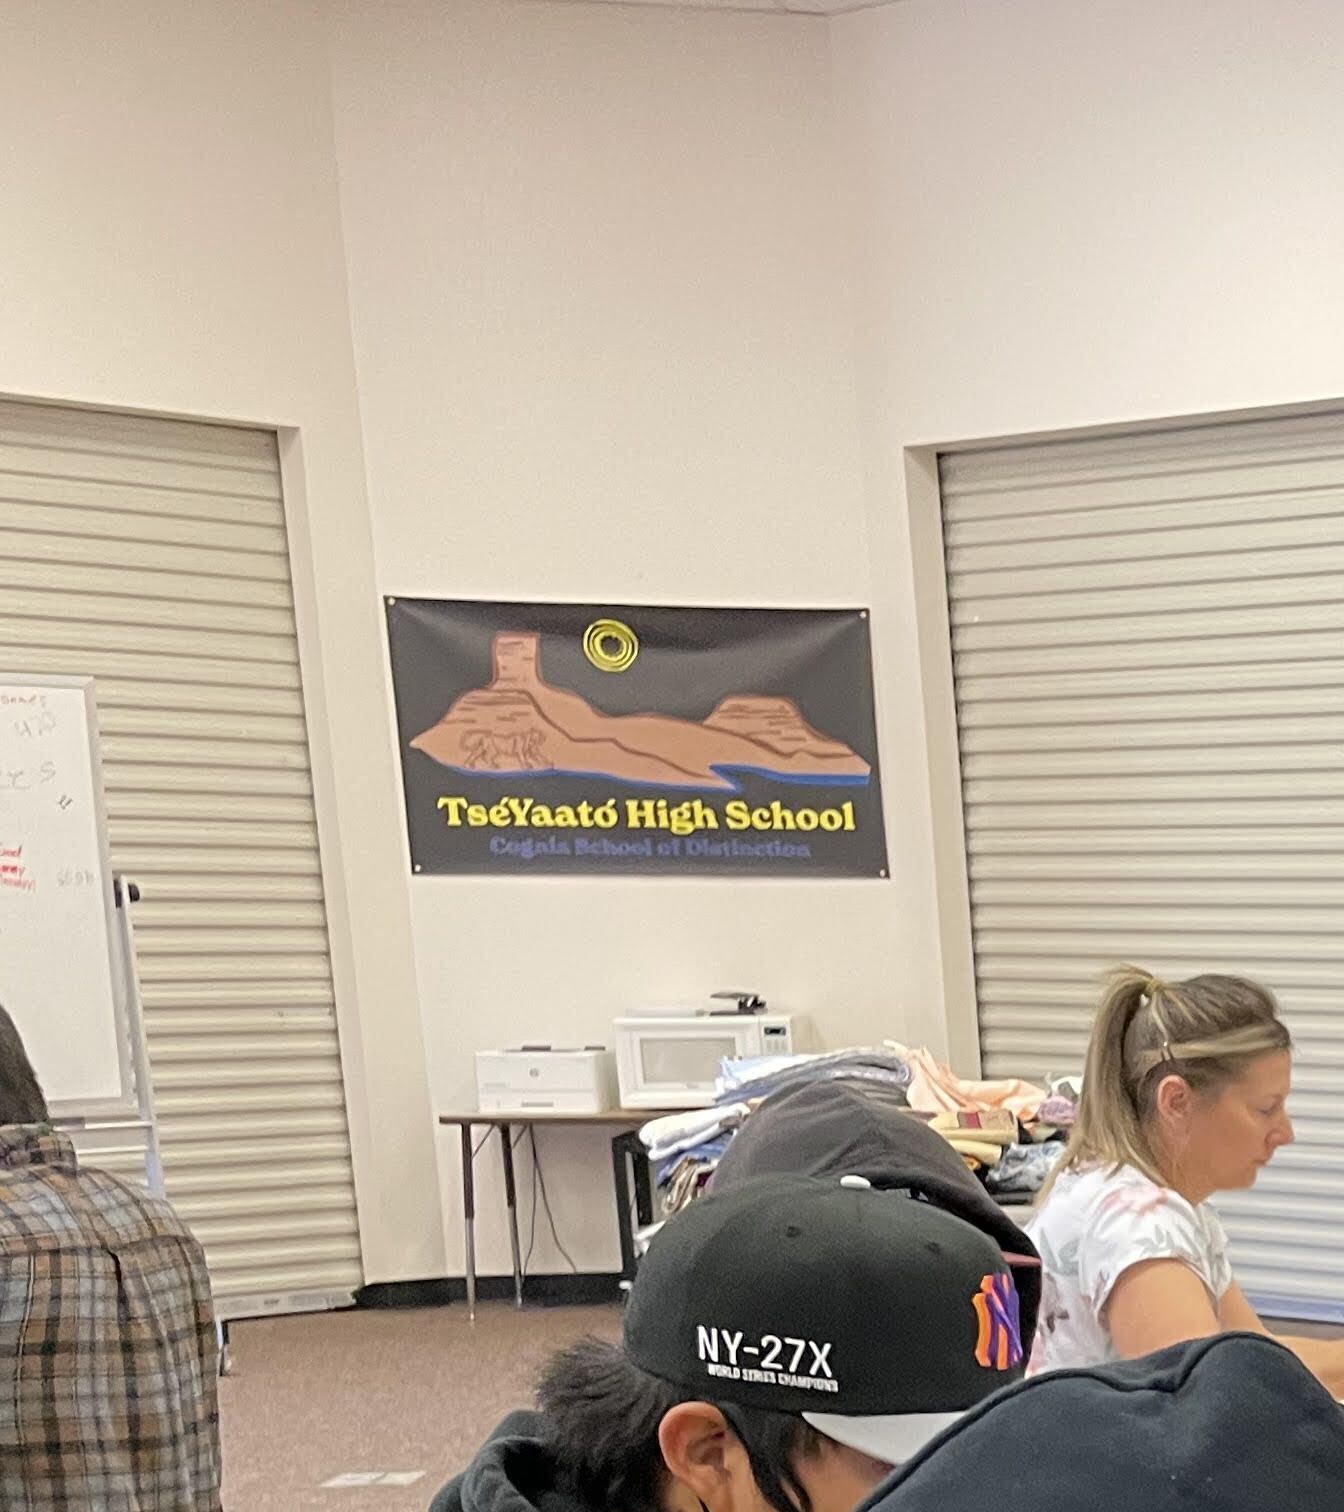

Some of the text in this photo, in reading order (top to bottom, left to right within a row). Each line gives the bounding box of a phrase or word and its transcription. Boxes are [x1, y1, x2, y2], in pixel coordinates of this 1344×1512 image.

[437, 796, 857, 836] TséYaató High School
[489, 832, 812, 859] Cognia School of Distinction
[696, 1324, 833, 1379] NY-27X
[707, 1362, 839, 1393] WORLD SERIES CHAMPIONS
